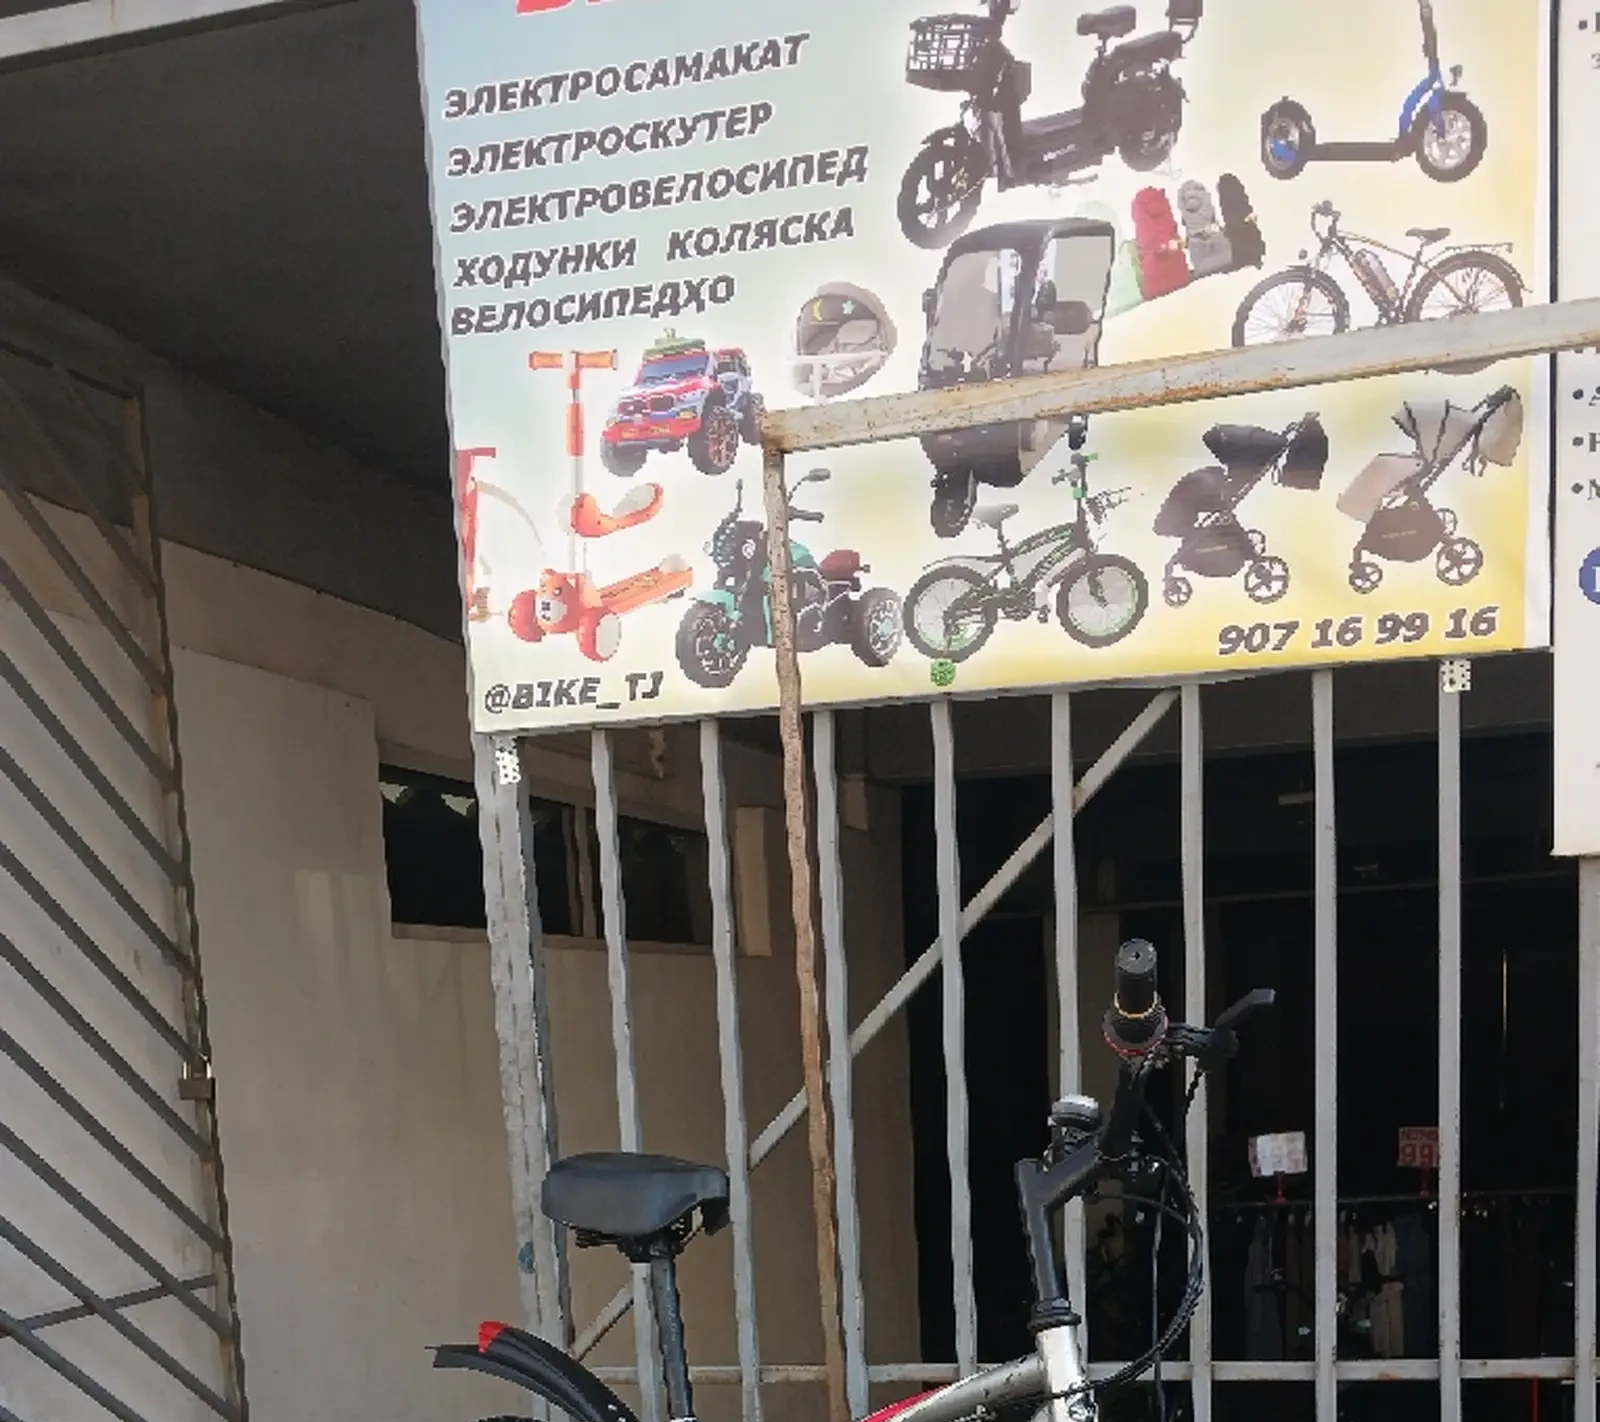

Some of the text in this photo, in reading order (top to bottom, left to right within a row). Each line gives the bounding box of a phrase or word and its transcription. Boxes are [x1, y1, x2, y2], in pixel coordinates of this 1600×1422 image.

[444, 32, 810, 118] ЭЛЕКТРОСАМАКАТ
[447, 102, 773, 176] ЭЛЕКТРОСКУТЕР
[450, 145, 869, 232] ЭЛЕКТРОВЕЛОСИПЕД
[453, 206, 855, 289] ХОДУНКИ КОЛЯСКА
[1219, 606, 1499, 655] 907 16 99 16
[484, 671, 664, 714] @BIKE_TJ
